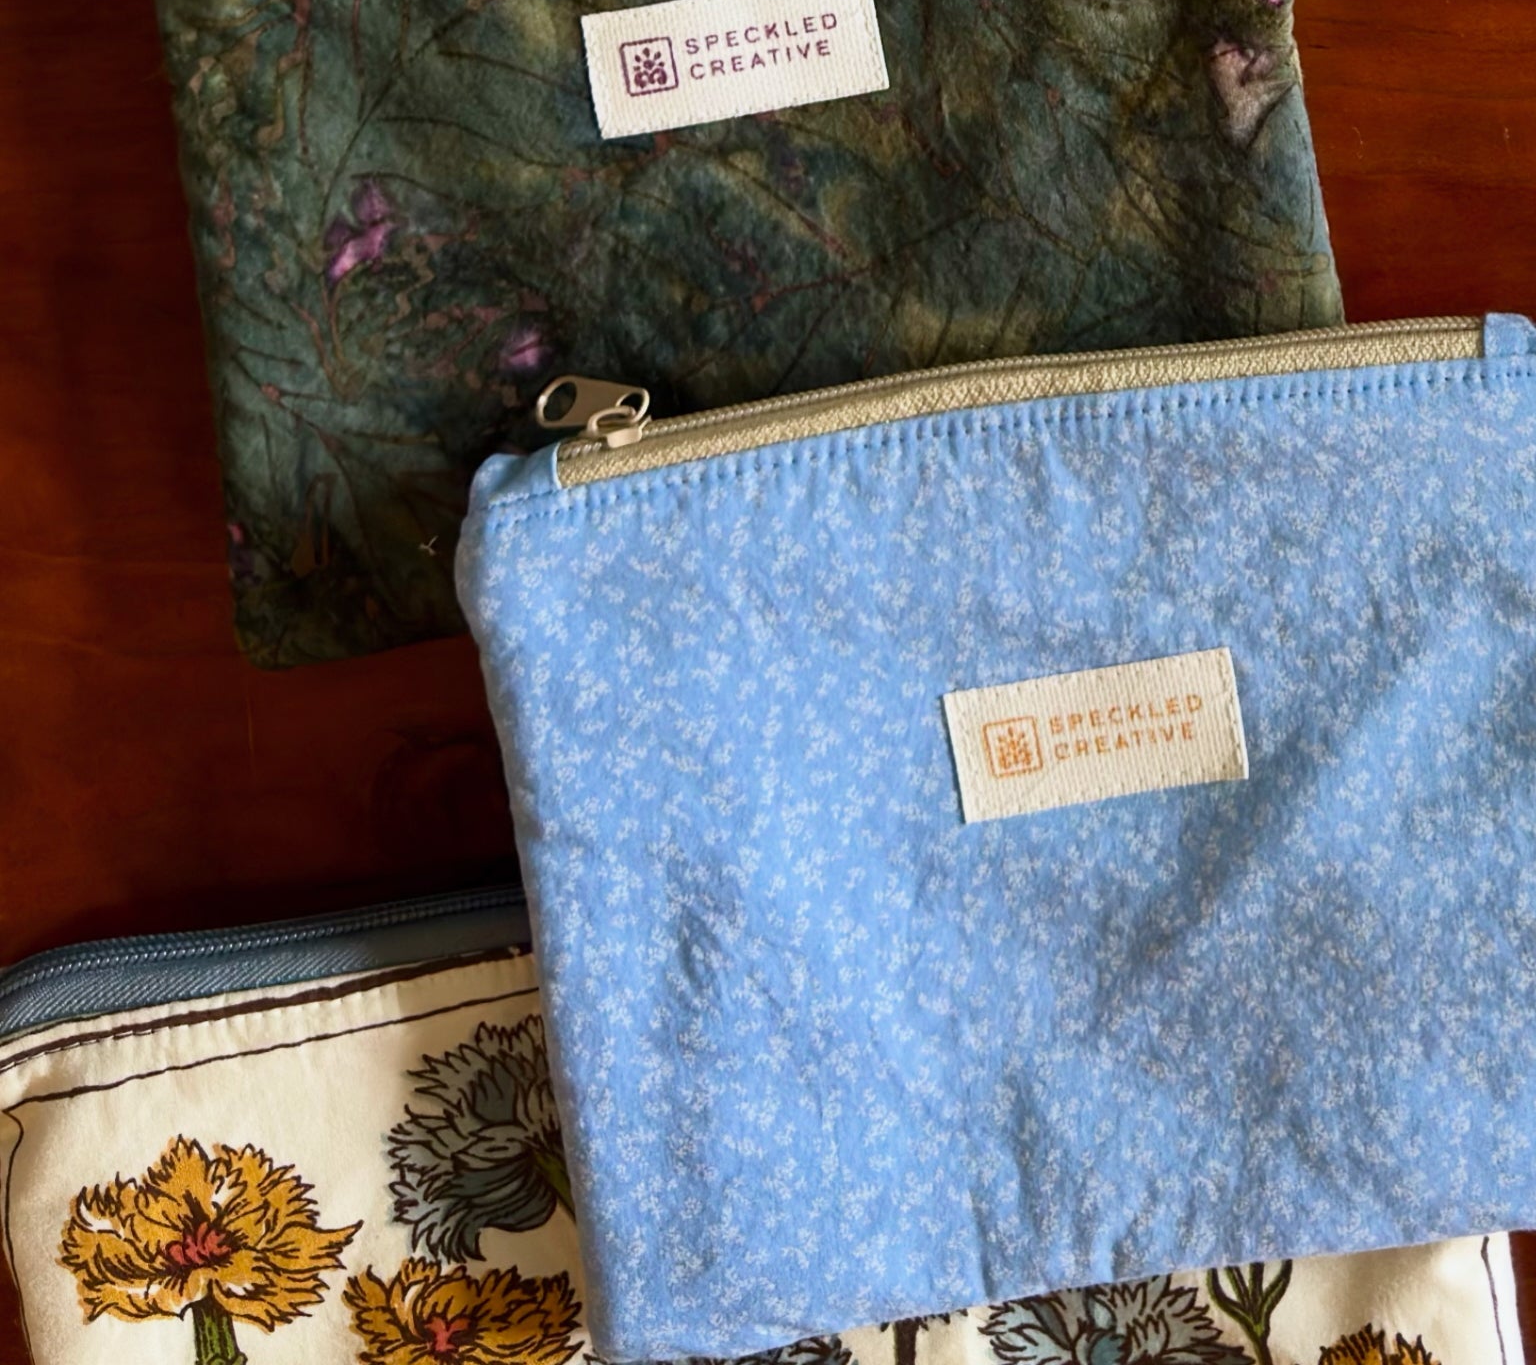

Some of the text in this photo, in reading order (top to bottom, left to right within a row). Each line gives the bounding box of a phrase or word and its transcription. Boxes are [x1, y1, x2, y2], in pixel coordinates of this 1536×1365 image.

[685, 13, 838, 55] SPECKLED
[690, 40, 832, 80] CREATIVE
[1050, 693, 1203, 735] SPECKLED
[1054, 722, 1195, 761] CREATIVE
